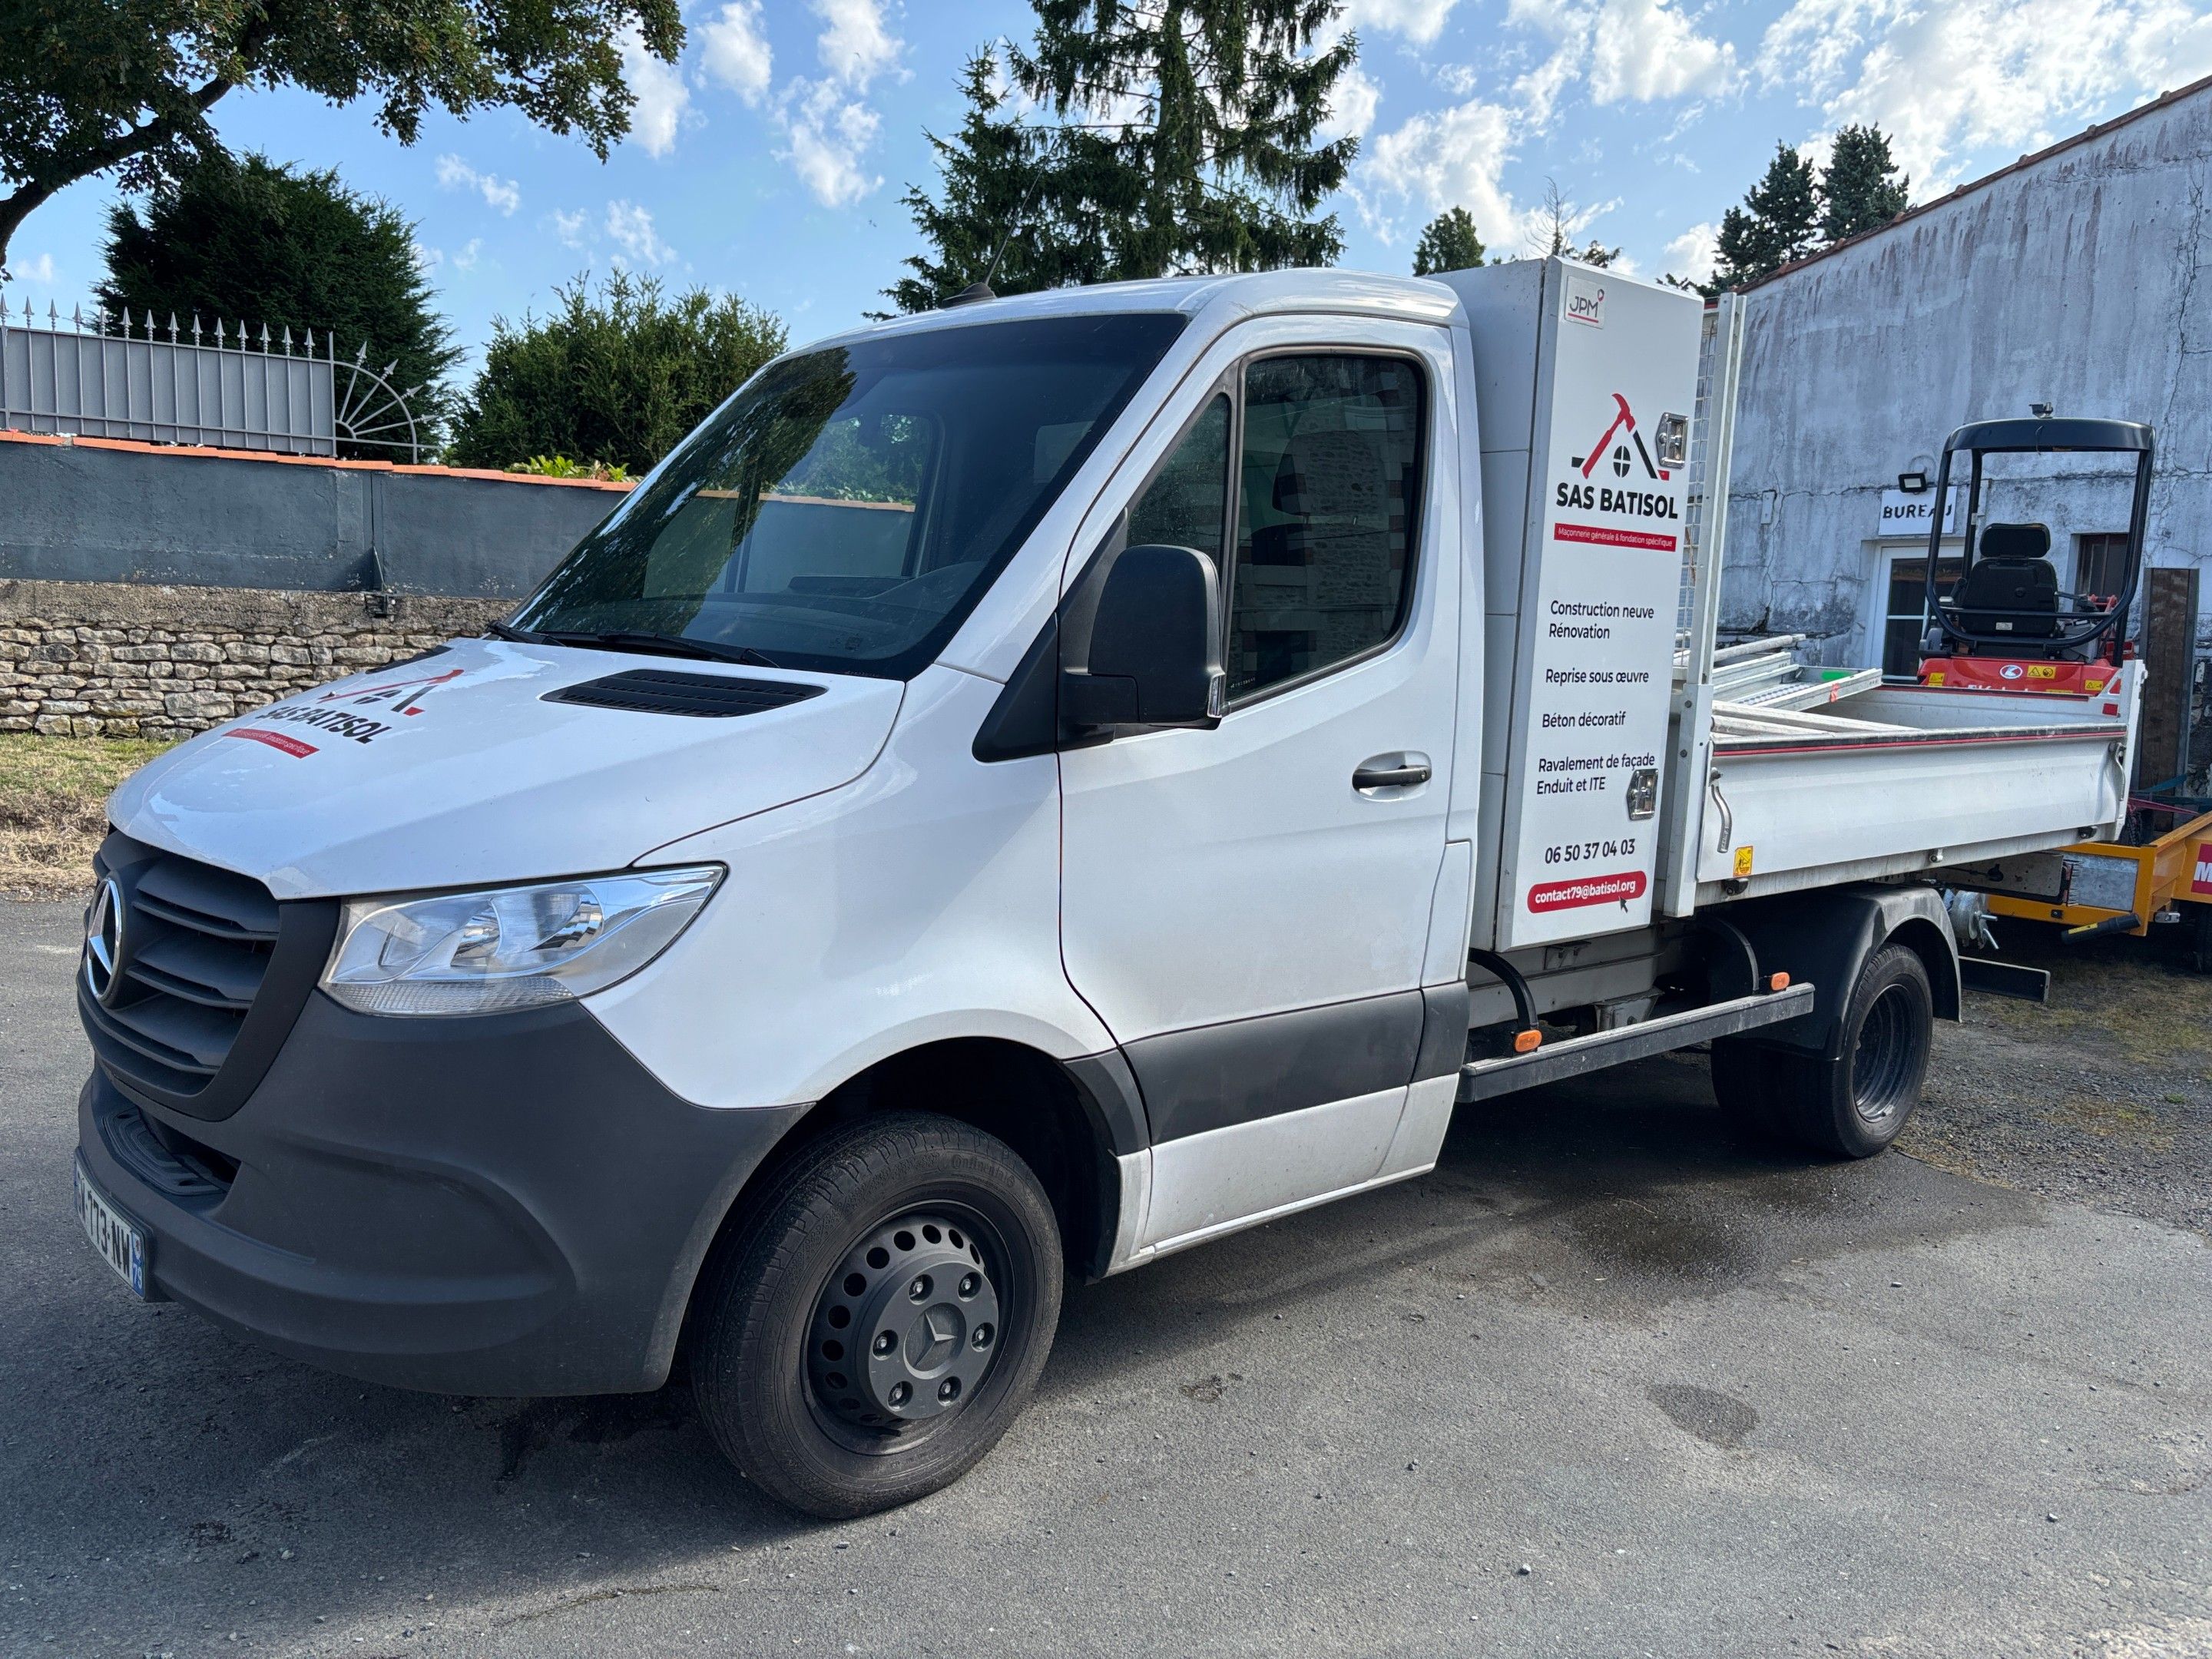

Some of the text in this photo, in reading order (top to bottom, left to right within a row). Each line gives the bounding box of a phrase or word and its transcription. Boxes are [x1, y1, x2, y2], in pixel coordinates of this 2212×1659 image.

[1569, 296, 1598, 318] JPM
[1556, 482, 1678, 519] SAS BATISOL
[1558, 527, 1591, 538] Maçonnerie
[1591, 531, 1614, 541] générale
[1619, 535, 1645, 544] fondation
[1646, 538, 1673, 547] spécifique
[1550, 600, 1654, 619] Construction neuve
[1548, 622, 1610, 639] Rénovation
[1545, 667, 1649, 686] Reprise sous œuvre
[286, 708, 392, 744] BATISOL
[1542, 710, 1627, 728] Béton décoratif
[1538, 752, 1655, 773] Ravalement de façade
[1537, 777, 1606, 795] Enduit et ITE
[1545, 838, 1636, 864] 06 50 37 04 03
[1535, 879, 1636, 903] contact79@batisol.org
